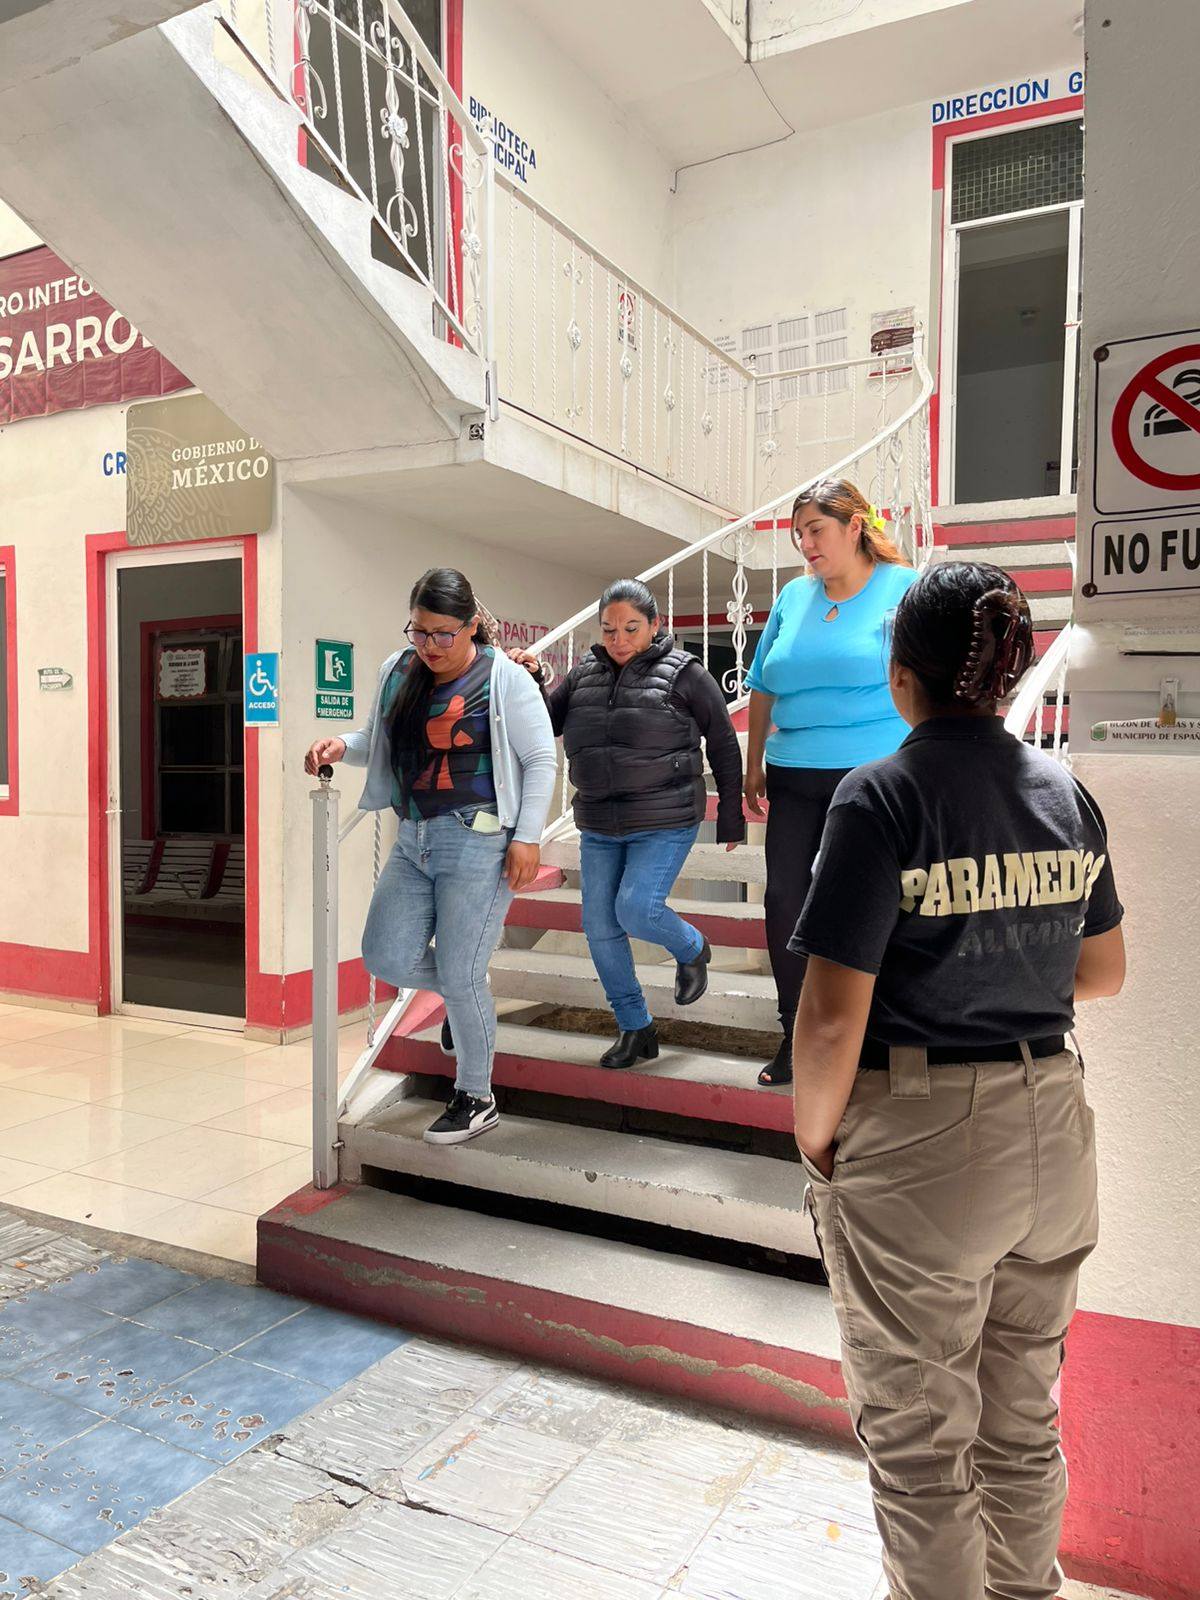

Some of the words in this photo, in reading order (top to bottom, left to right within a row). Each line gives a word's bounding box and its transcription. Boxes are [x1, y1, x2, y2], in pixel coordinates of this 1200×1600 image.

[932, 78, 1049, 123] DIRECCIÓN
[470, 96, 536, 169] BIBIOTECA
[29, 276, 97, 310] INTEG
[0, 310, 154, 380] SARRO
[103, 451, 126, 476] CR
[172, 439, 246, 462] GOBIERNO
[249, 437, 263, 450] D
[172, 456, 269, 490] MÉXICO
[1104, 532, 1150, 576] NO
[1160, 527, 1200, 572] FU
[248, 701, 276, 709] ACCESO
[320, 695, 341, 706] SALIDA
[342, 696, 349, 706] DE
[1112, 731, 1157, 740] MUNICIPIO
[1158, 732, 1171, 740] DE
[1173, 731, 1200, 740] ESPAÑ
[1140, 720, 1151, 729] DE
